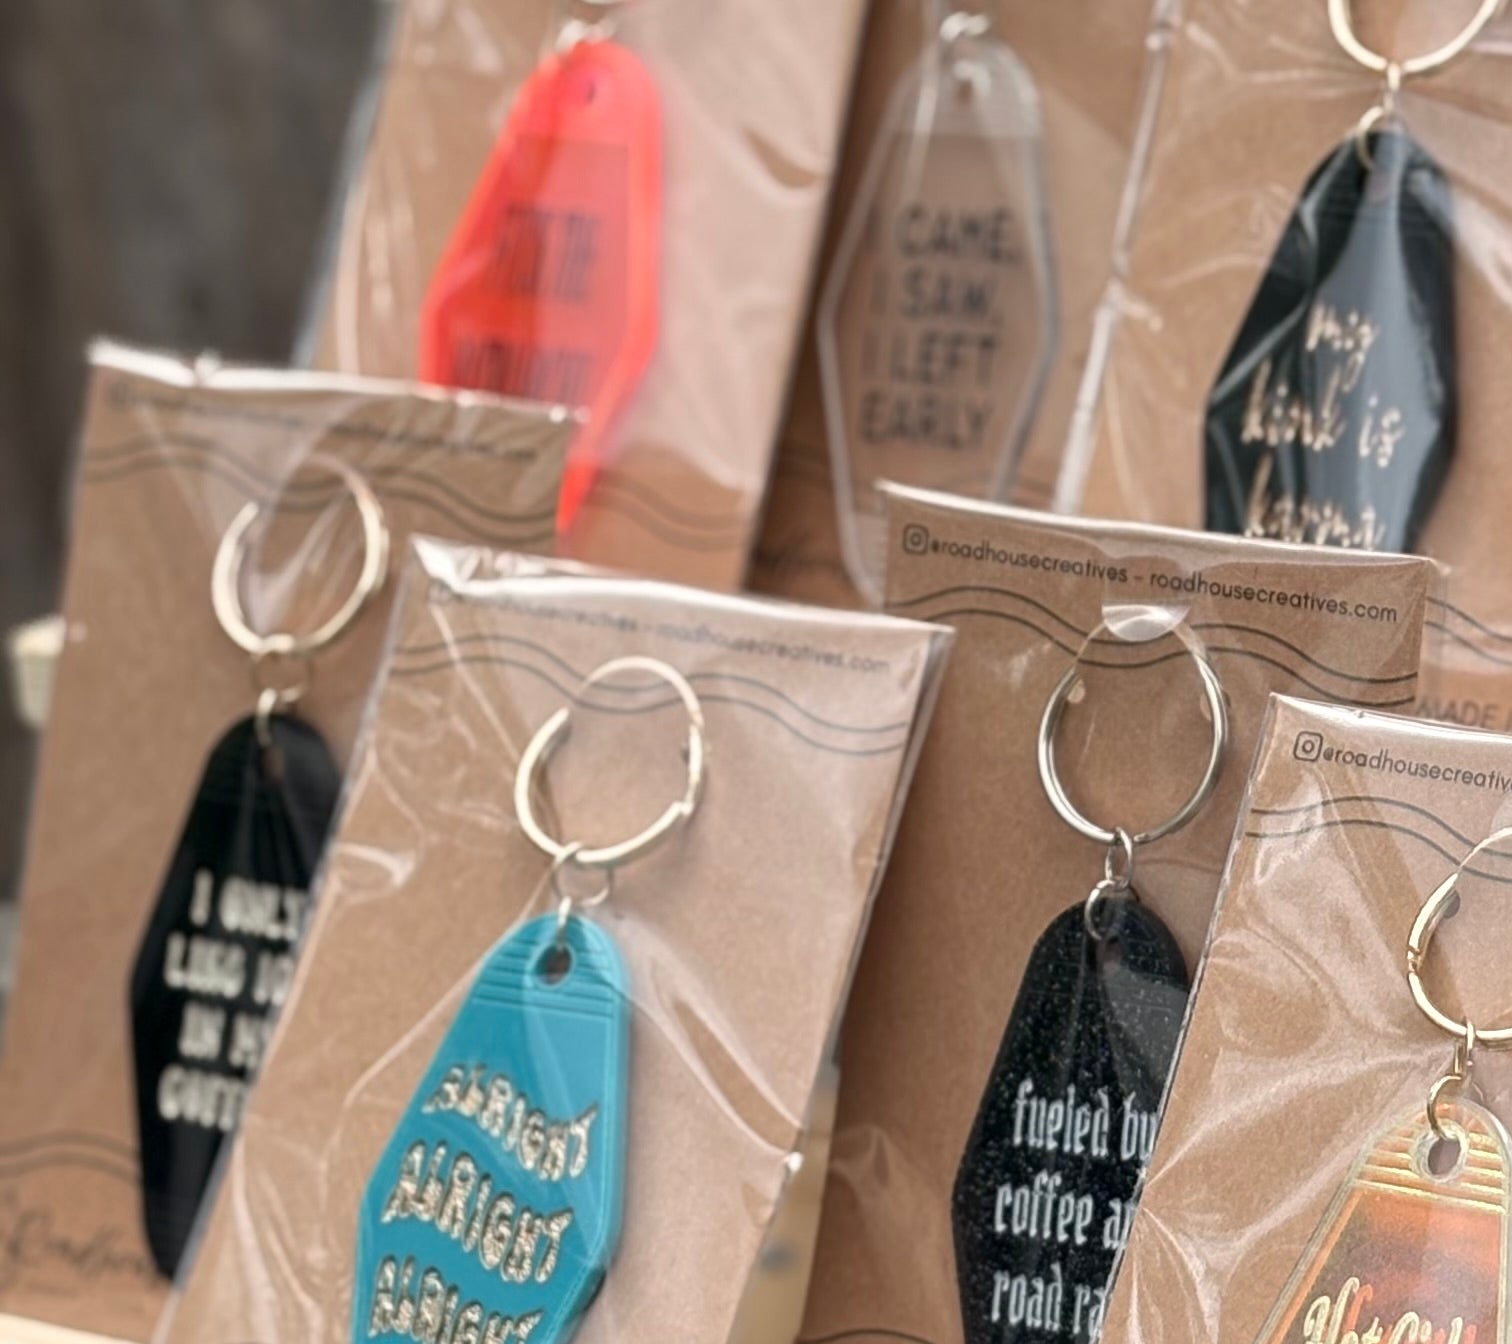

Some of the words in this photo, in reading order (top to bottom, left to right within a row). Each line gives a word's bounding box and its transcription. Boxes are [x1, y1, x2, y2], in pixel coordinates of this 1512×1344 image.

[896, 204, 1021, 265] CAME
[899, 264, 996, 319] SAW
[892, 328, 999, 387] LEFT
[861, 388, 993, 450] EARLY
[929, 536, 1128, 584] @roadhousecreatives
[1150, 571, 1399, 623] roadhousecreatives.com
[421, 1061, 599, 1183] ALRIGHT
[1013, 1077, 1111, 1158] fueled
[380, 1138, 575, 1285] ALRIGHT
[993, 1168, 1093, 1246] coffee
[991, 1262, 1062, 1332] road
